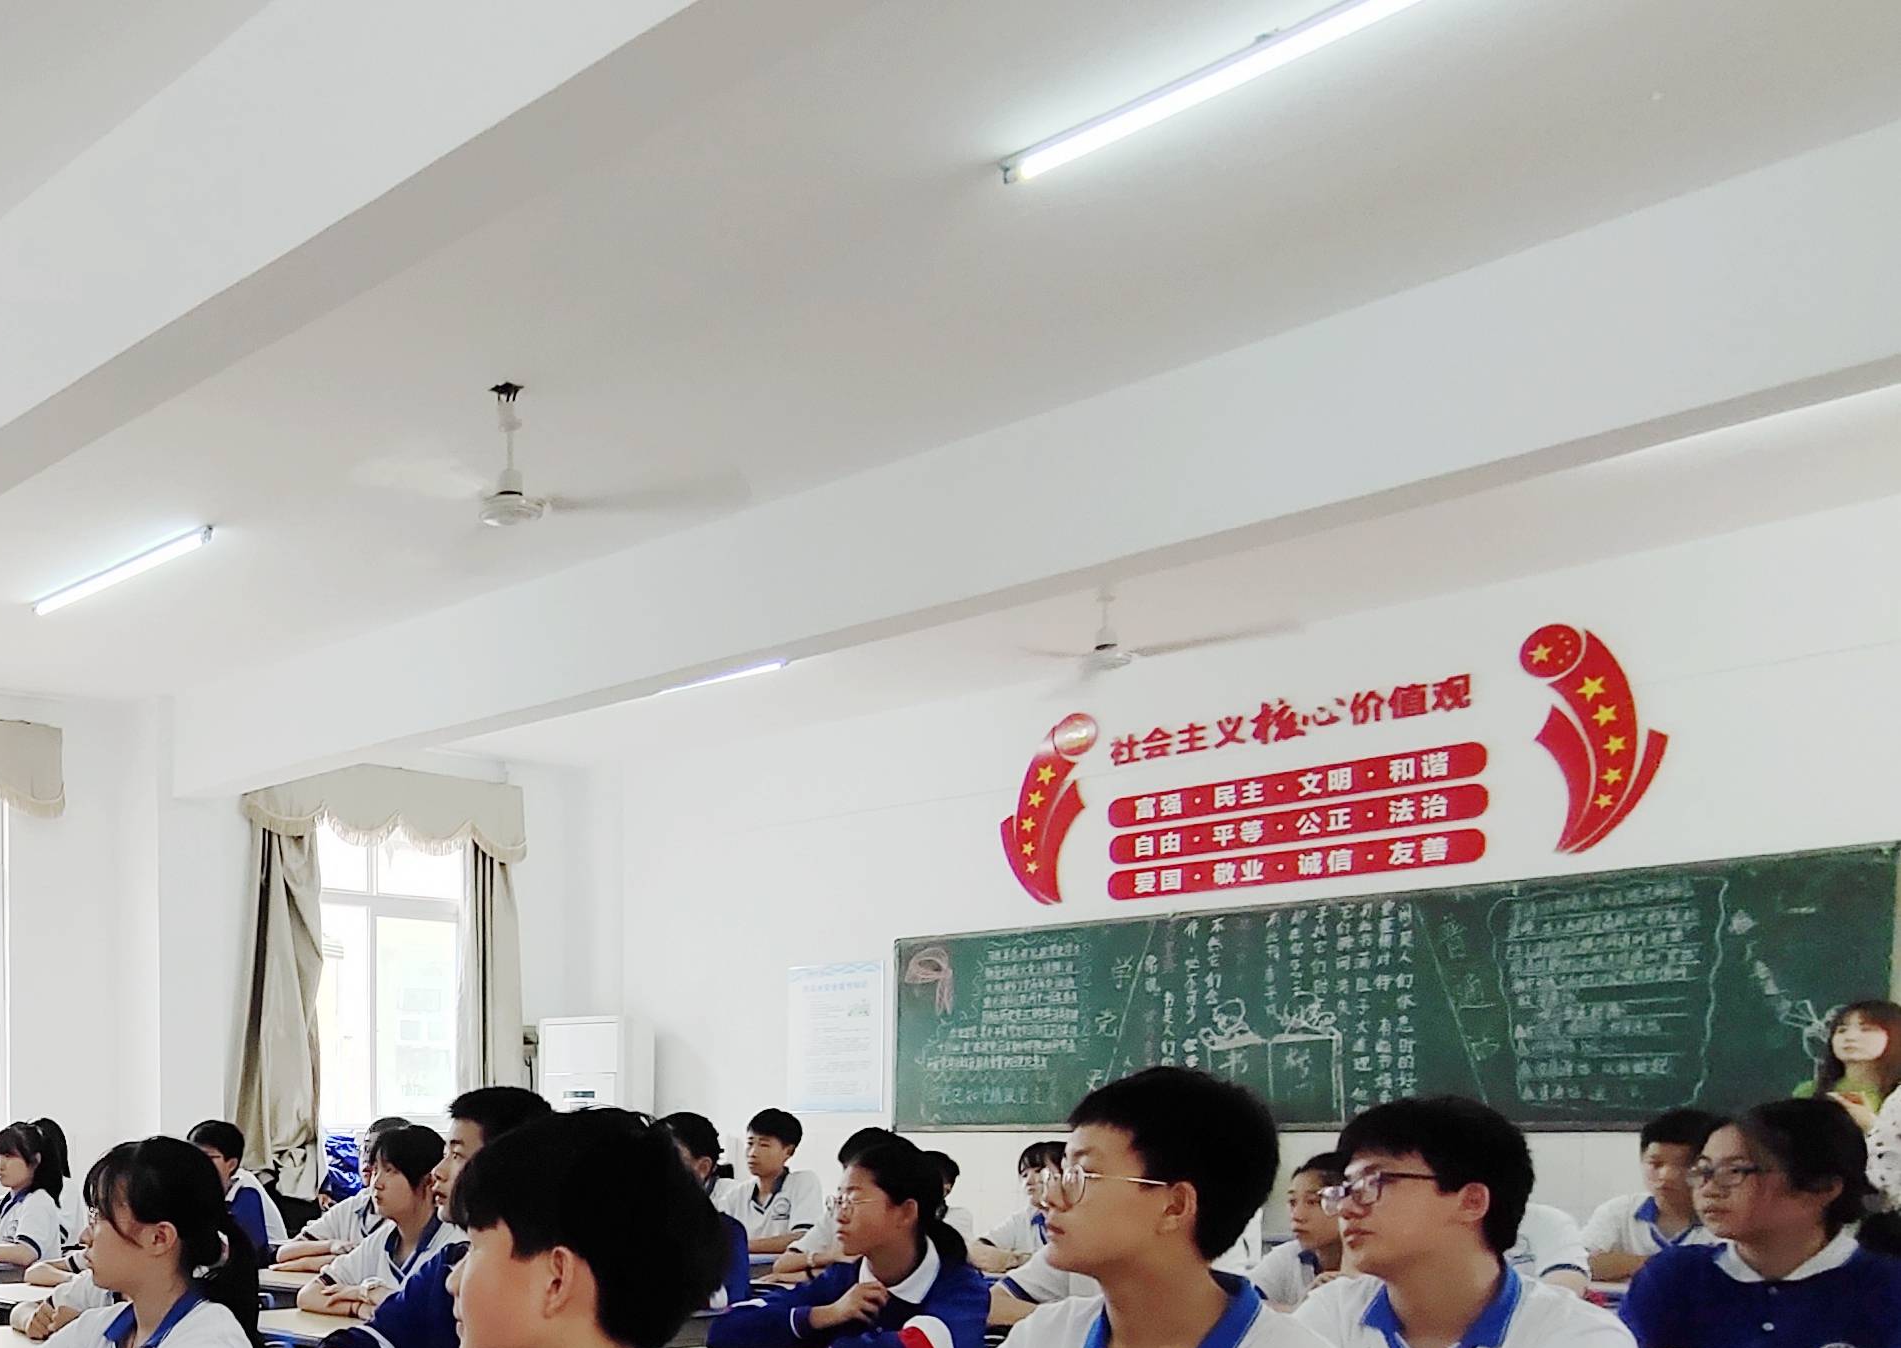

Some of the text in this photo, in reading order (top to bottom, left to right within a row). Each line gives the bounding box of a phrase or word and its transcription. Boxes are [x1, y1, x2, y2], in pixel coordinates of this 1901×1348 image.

[1110, 673, 1472, 766] 社会主义核心价值观
